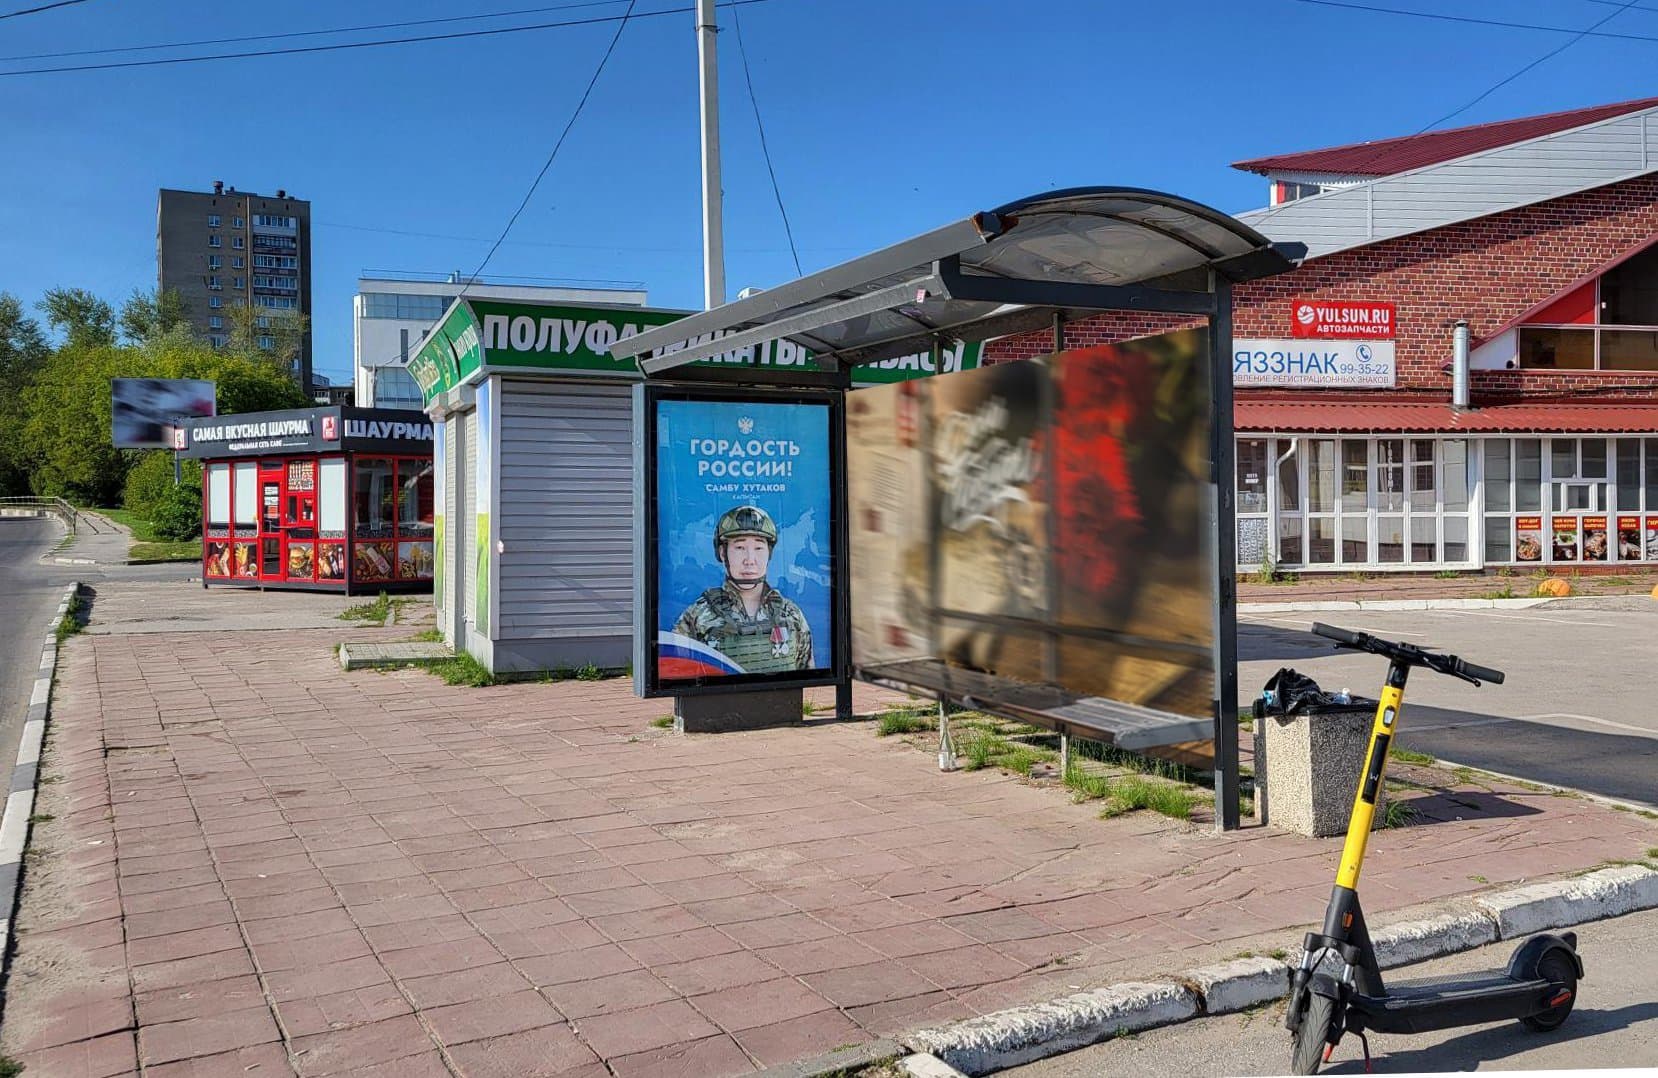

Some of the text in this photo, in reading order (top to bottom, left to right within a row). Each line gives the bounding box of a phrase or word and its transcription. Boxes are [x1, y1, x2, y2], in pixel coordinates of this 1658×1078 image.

[1316, 307, 1390, 324] YULSUN.RU
[1317, 325, 1390, 334] АВТОЗАПЧАСТИ
[484, 314, 807, 366] ПОЛУФКАТЫ
[1234, 351, 1339, 375] ЯЗЗНАК
[1340, 363, 1389, 375] 99-35-22
[1233, 375, 1390, 385] ОВЛЕНИЕ РЕГИСТРАЦИОННЫХ ЗНАКОВ
[193, 425, 223, 442] САМАЯ
[225, 422, 267, 441] ВКУСНАЯ
[268, 419, 310, 438] ШАУРМА
[344, 419, 434, 441] ШАУРМА
[690, 439, 800, 457] ГОРДОСТЬ
[698, 460, 793, 477] РОССИИ!
[705, 483, 786, 492] САМБУ ХУТАКОВ
